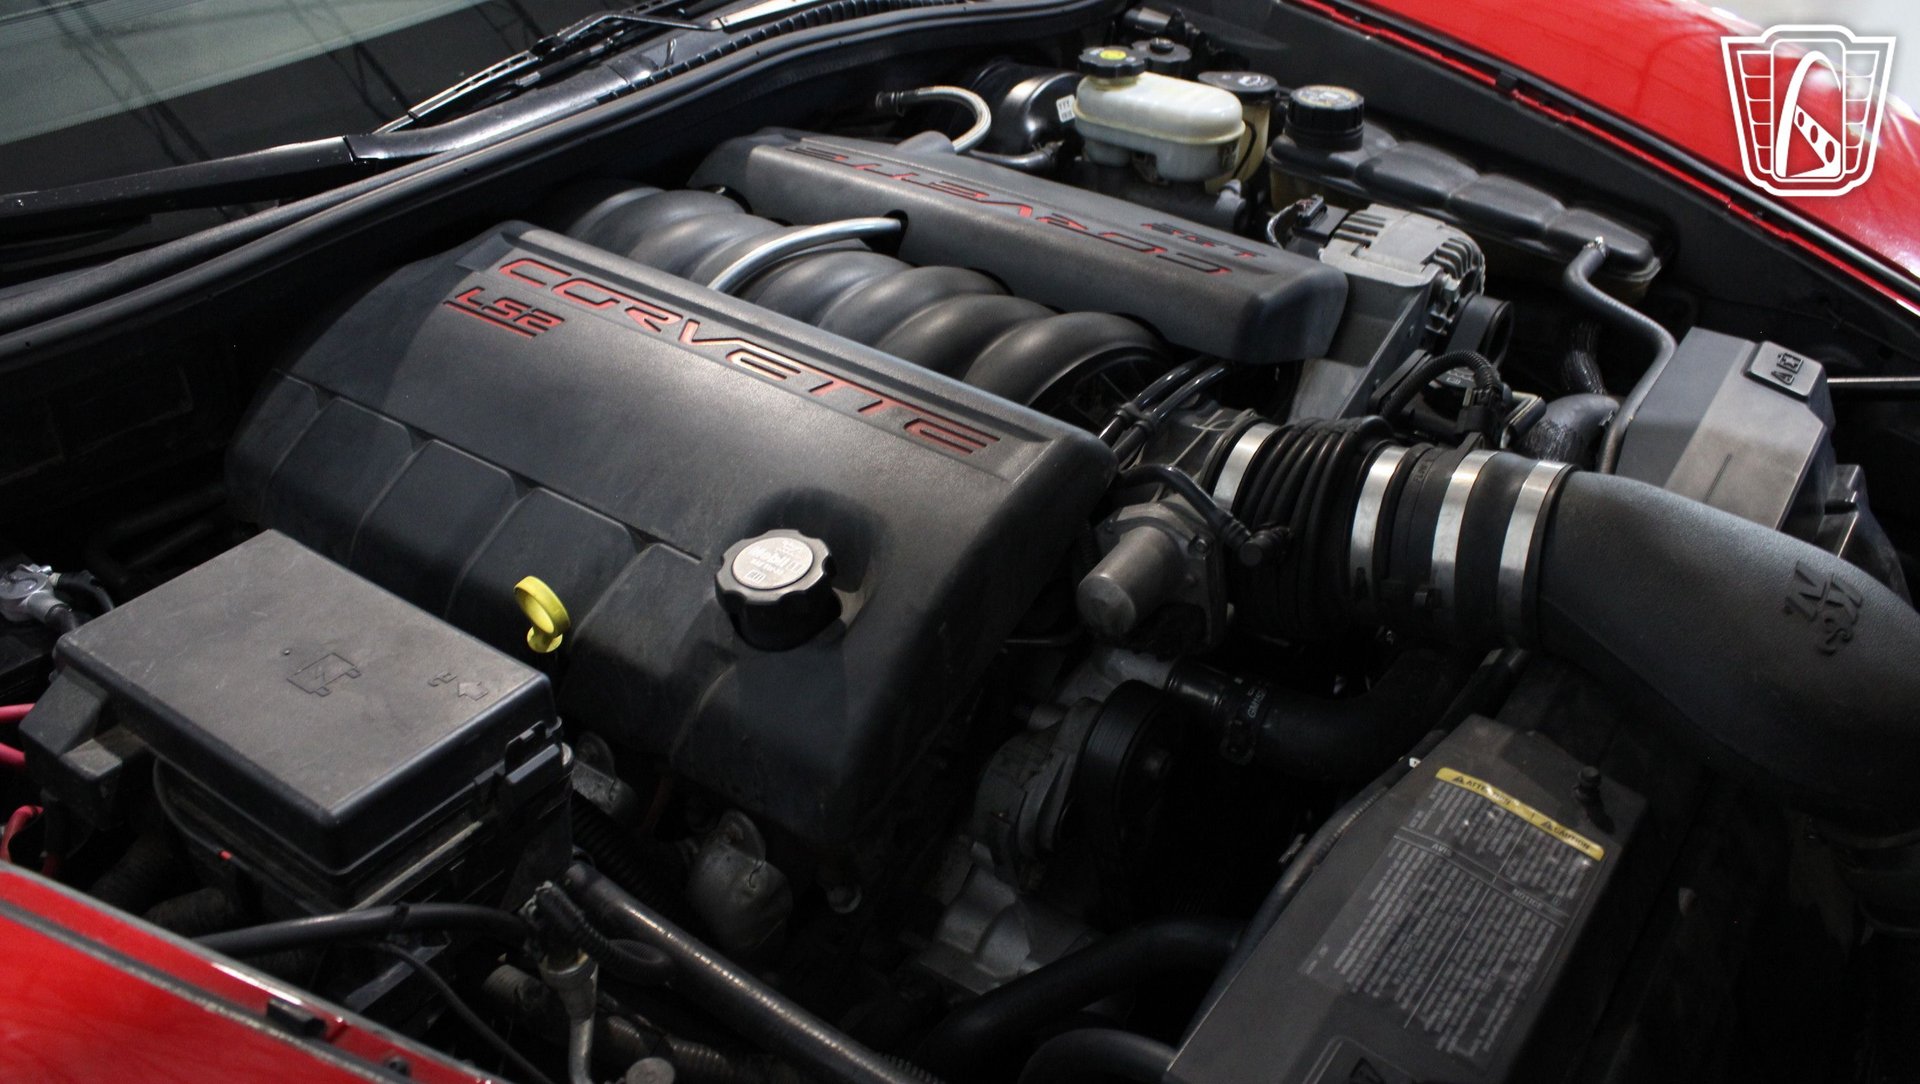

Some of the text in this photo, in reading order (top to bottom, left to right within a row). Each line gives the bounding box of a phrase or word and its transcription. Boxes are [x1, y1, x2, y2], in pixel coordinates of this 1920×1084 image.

[786, 146, 1232, 274] CORVETTE
[443, 285, 566, 339] LS2
[498, 257, 1001, 455] CORVETTE
